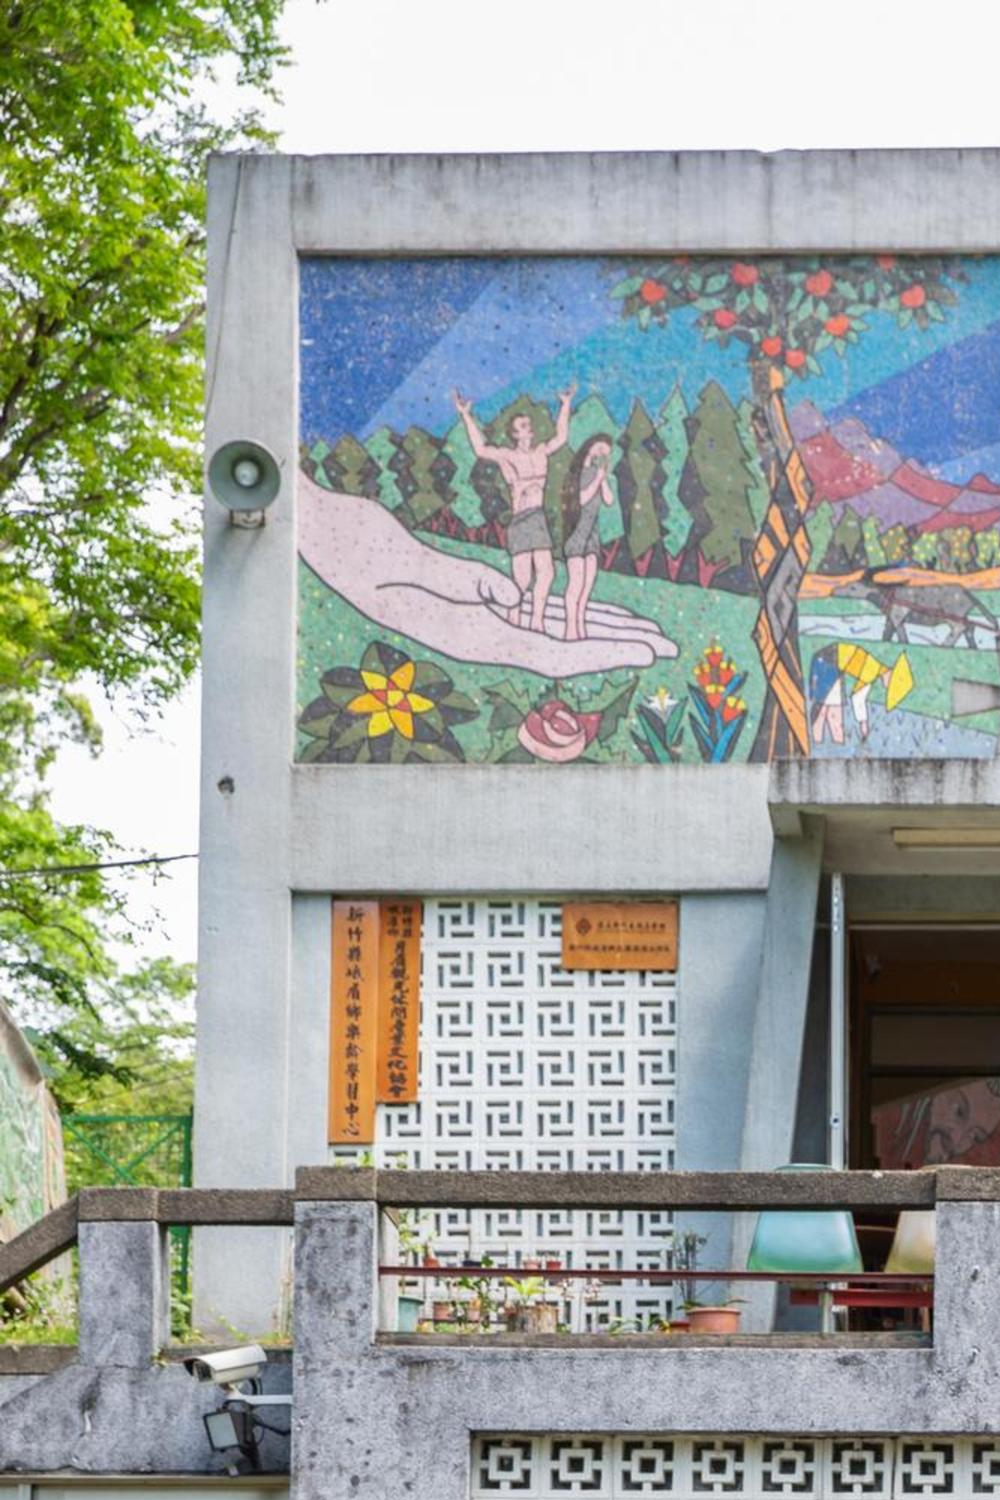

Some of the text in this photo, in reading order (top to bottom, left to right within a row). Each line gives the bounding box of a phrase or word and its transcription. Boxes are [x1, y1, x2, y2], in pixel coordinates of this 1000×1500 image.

[342, 905, 365, 1136] 新竹縣峨眉鄉樂齡學習中心
